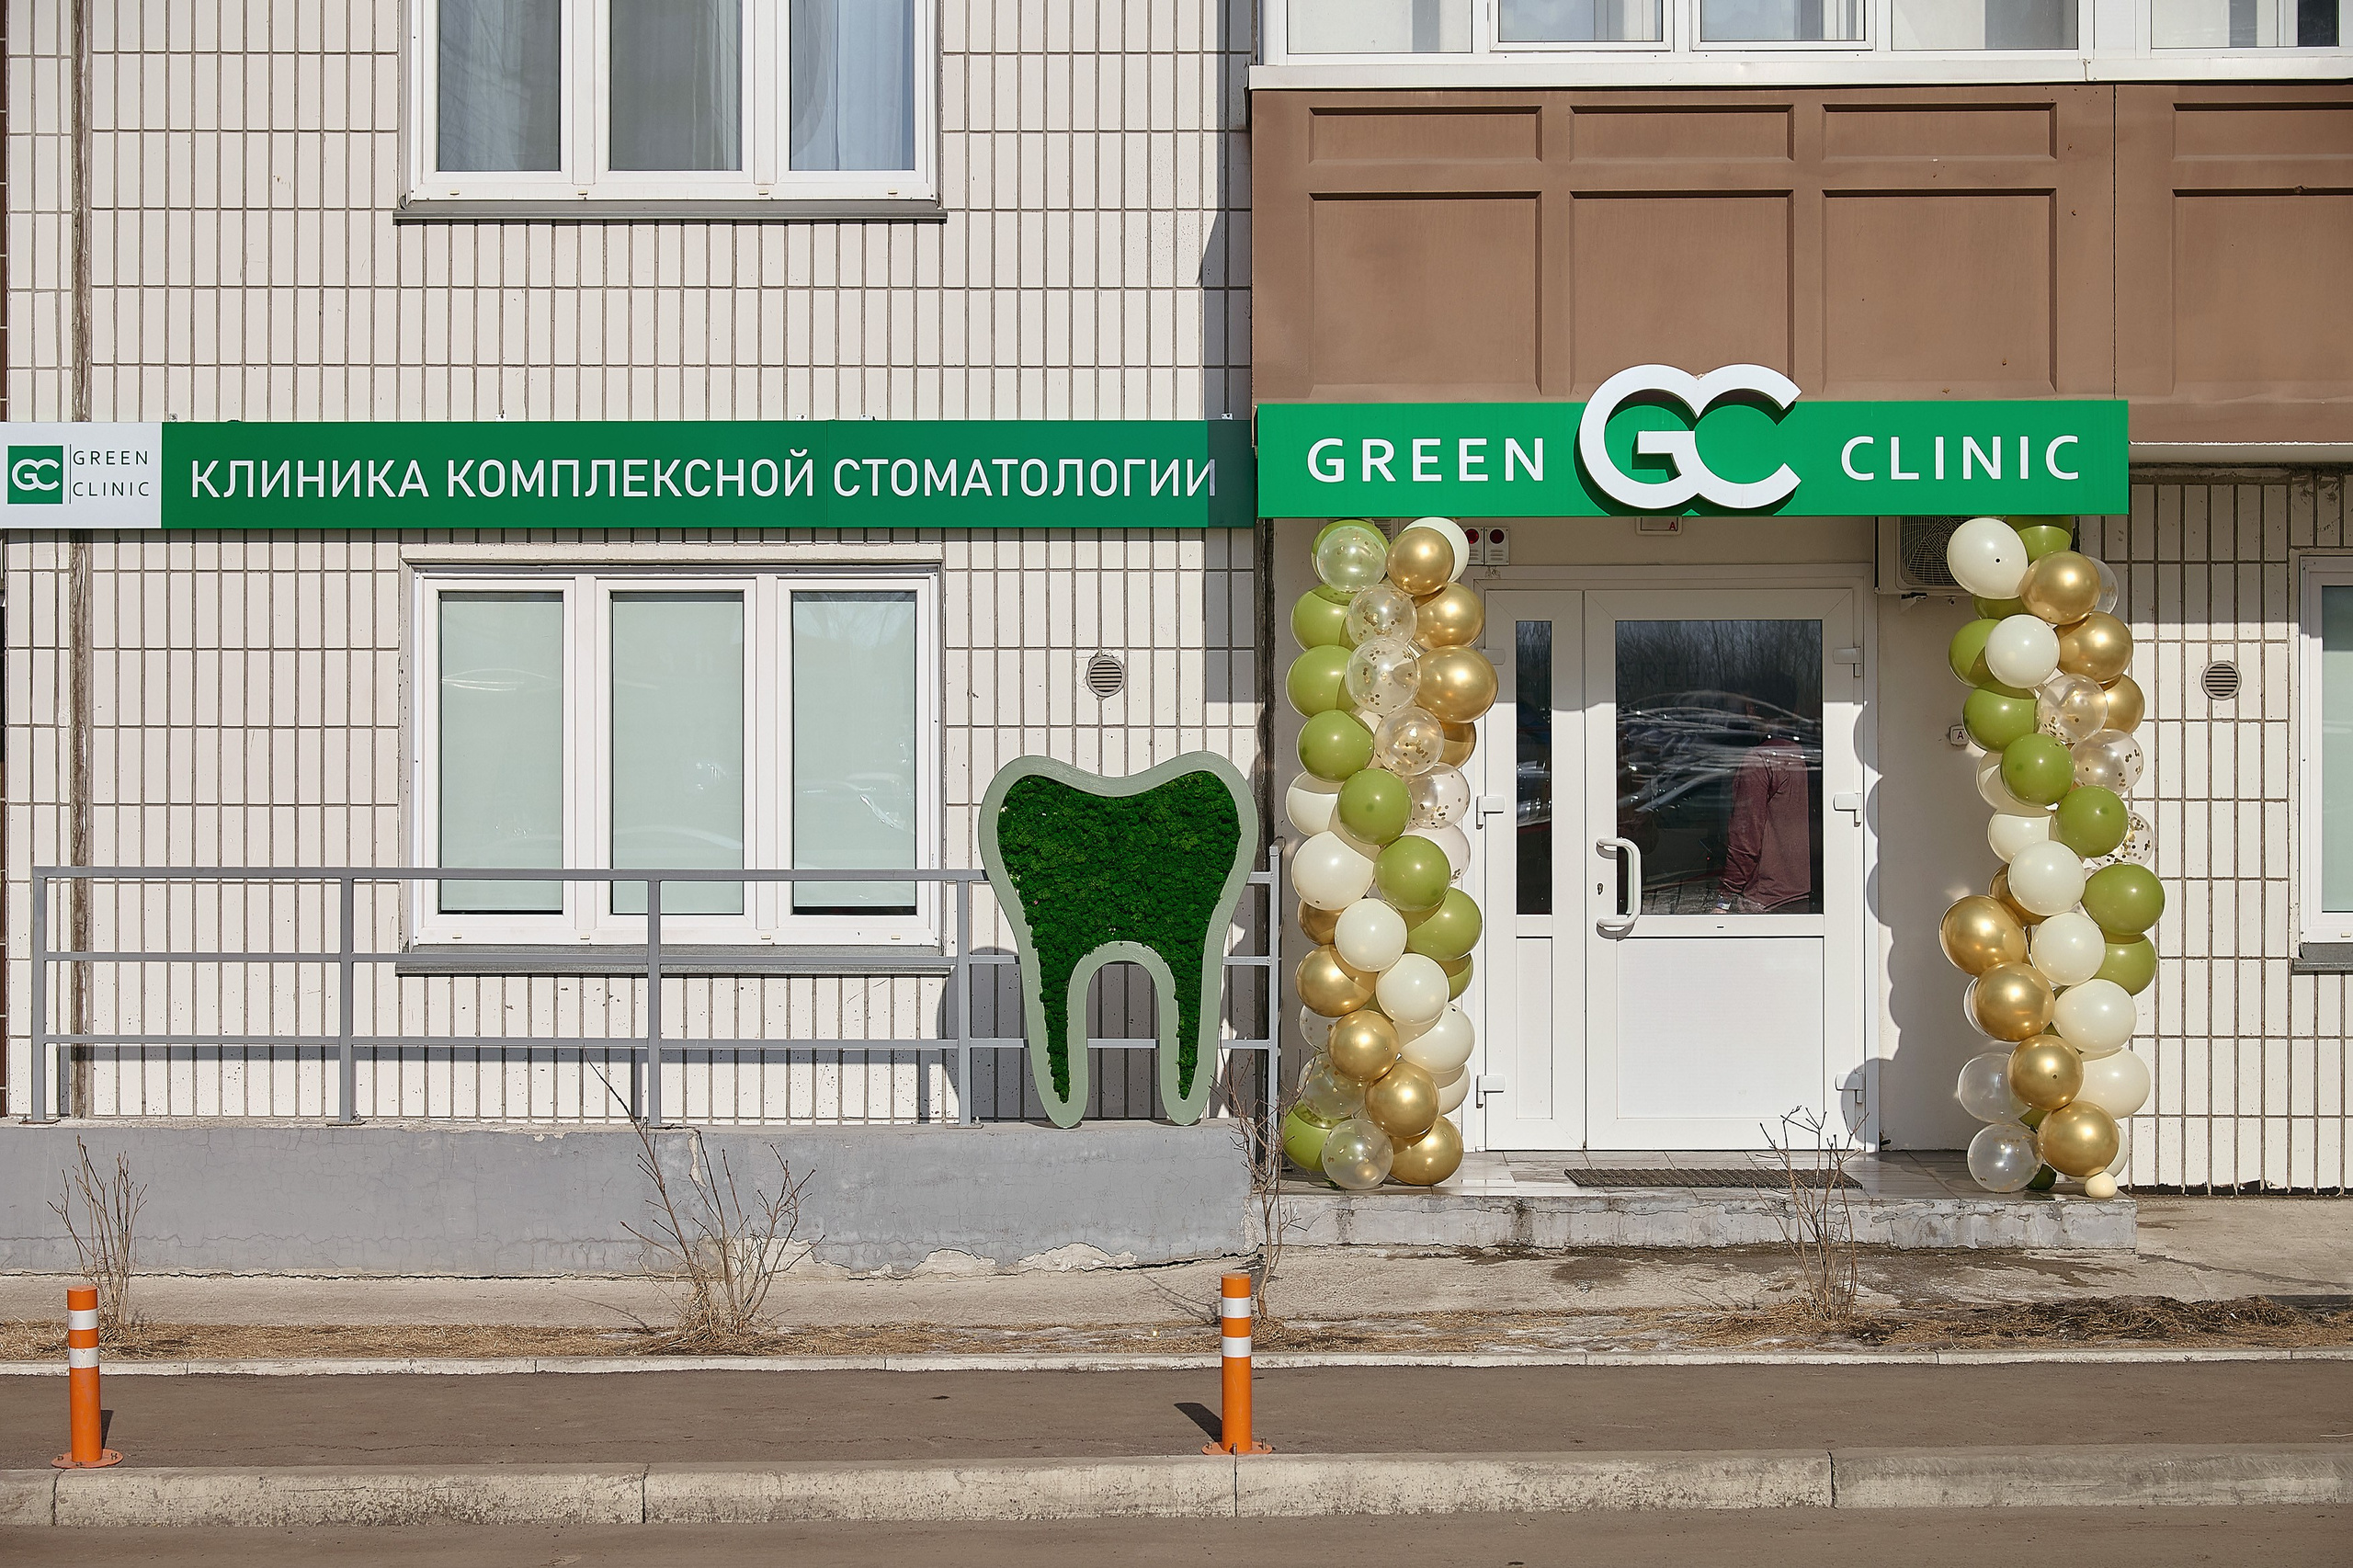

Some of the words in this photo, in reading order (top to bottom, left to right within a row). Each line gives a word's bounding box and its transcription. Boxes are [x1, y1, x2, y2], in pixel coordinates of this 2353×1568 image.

[1307, 437, 1544, 483] GREEN
[1580, 363, 1802, 510] GC
[1841, 436, 2079, 481] CLINIC
[11, 458, 60, 492] GC
[73, 450, 148, 466] GREEN
[191, 460, 430, 498] КЛИНИКА
[448, 449, 813, 497] КОМПЛЕКСНОЙ
[834, 458, 1215, 497] СТОМАТОЛОГИИ
[73, 482, 150, 497] CLINIC
